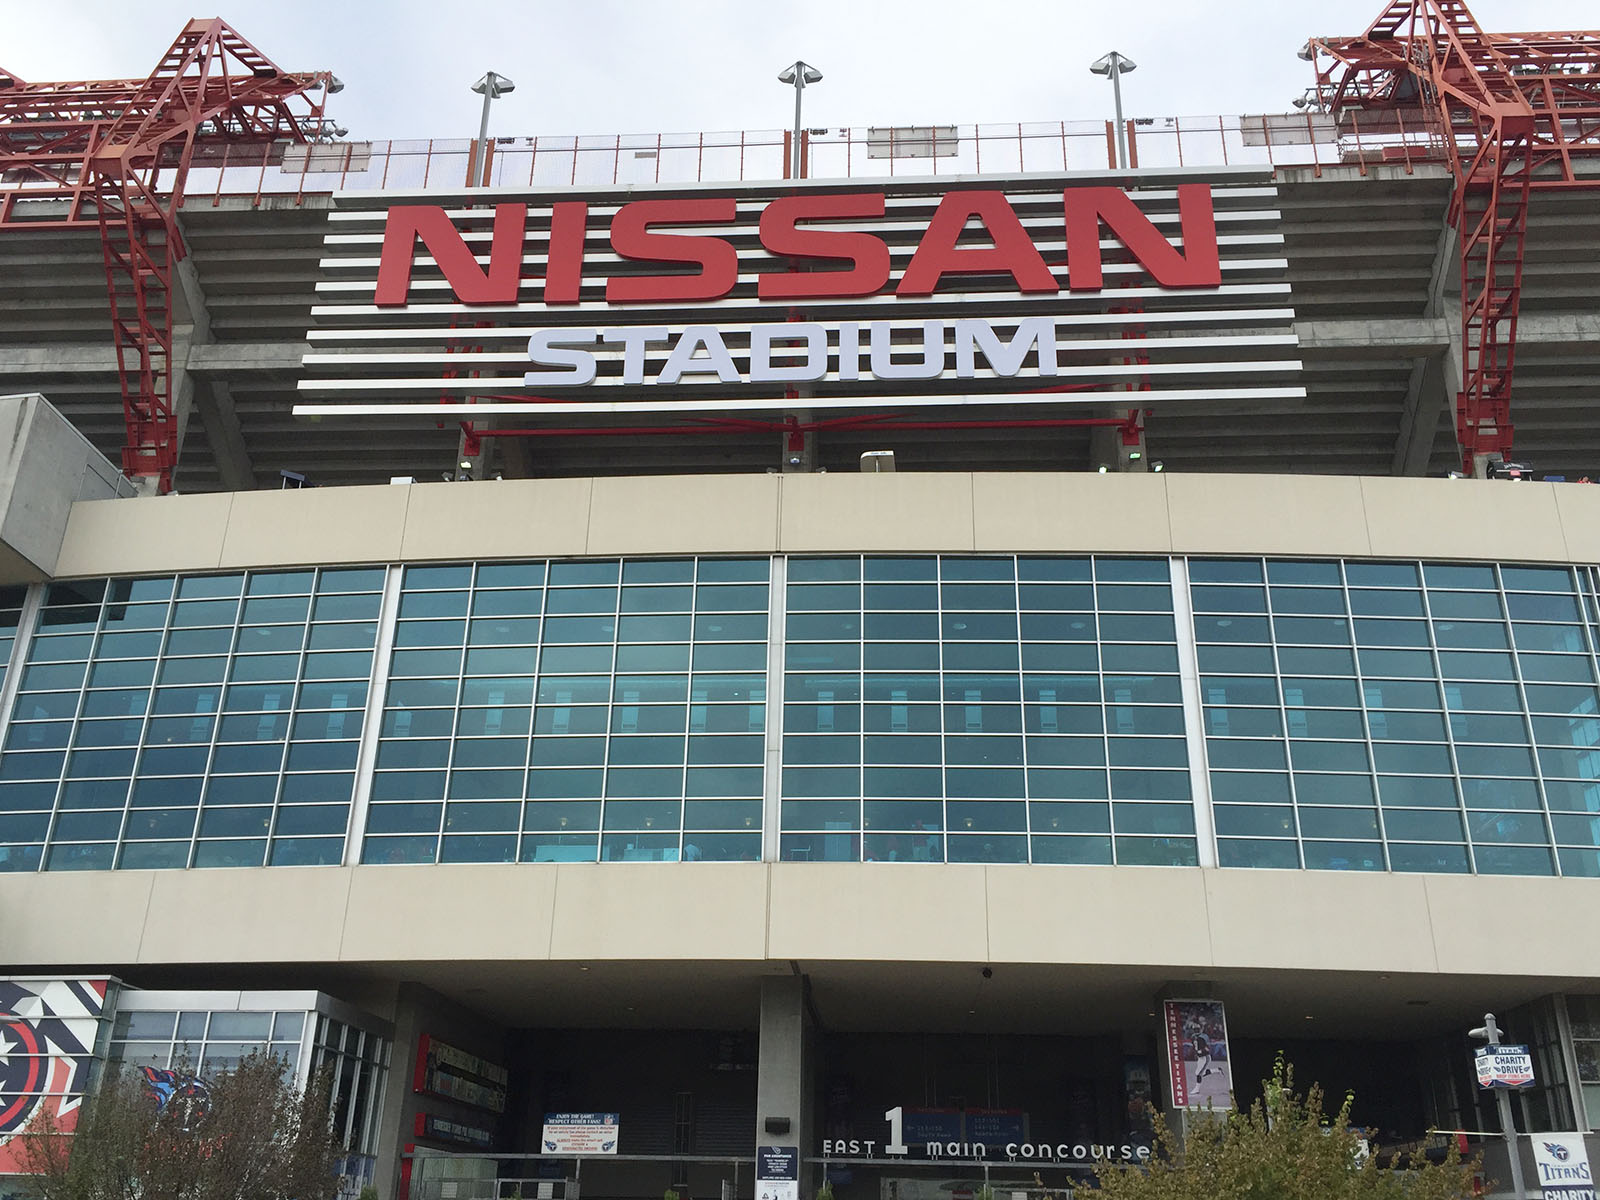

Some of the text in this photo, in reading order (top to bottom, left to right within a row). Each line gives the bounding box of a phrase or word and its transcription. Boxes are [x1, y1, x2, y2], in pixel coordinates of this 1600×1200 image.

[375, 184, 1221, 307] NISSAN
[524, 317, 1058, 388] STADIUM
[1169, 1003, 1184, 1104] TENNESSEE TITANS
[1494, 1056, 1526, 1065] CHARITY
[1501, 1065, 1524, 1074] DRIVE
[823, 1106, 1151, 1160] EAST 1 main concourse
[1538, 1161, 1590, 1181] TITANS
[1544, 1189, 1594, 1200] CHARITY
